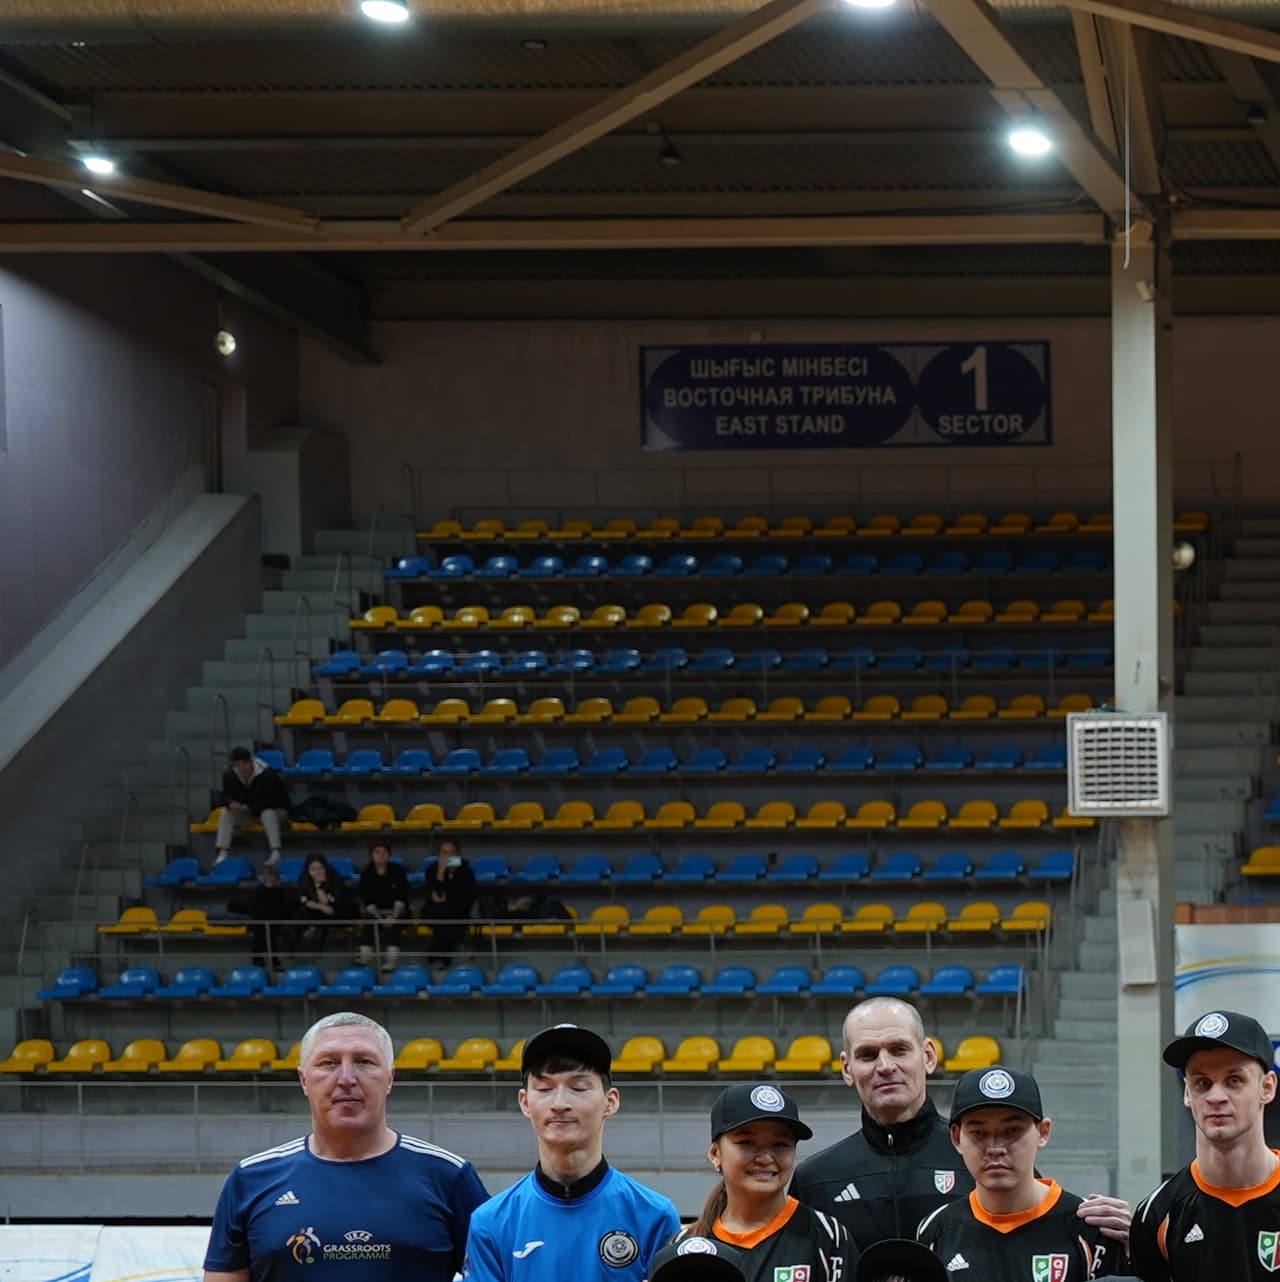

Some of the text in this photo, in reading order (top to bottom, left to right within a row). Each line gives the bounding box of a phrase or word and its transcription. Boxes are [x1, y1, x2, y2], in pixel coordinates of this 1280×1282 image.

[690, 357, 868, 378] ШЫҒЫС МІНБЕСІ
[960, 346, 988, 411] 1
[664, 386, 896, 407] ВОСТОЧНАЯ ТРИБУНА
[716, 416, 844, 436] EAST STAND
[939, 414, 1024, 434] SECTOR
[344, 1231, 373, 1242] UEFA
[323, 1244, 392, 1253] GRASSROOTS
[323, 1252, 392, 1260] PROGRAMME
